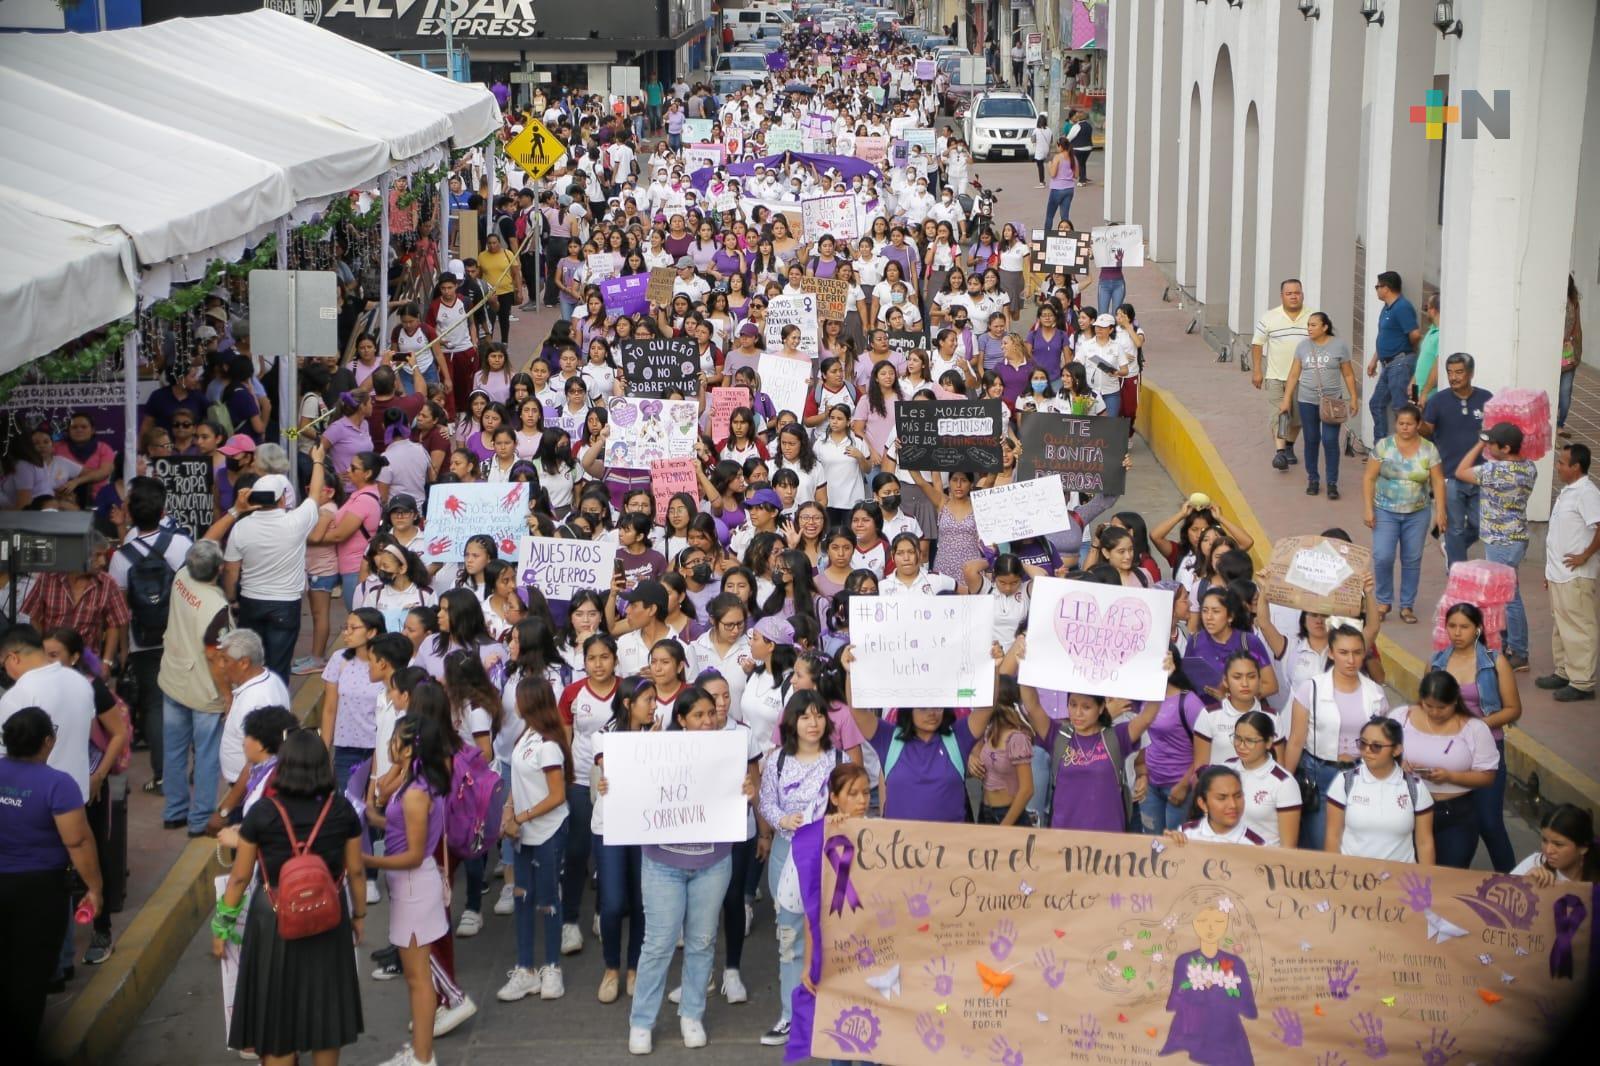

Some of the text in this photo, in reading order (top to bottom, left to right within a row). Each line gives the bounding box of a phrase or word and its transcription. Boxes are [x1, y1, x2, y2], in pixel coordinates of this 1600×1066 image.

[416, 19, 537, 36] EXPRESS
[649, 340, 693, 357] QUIERO
[889, 338, 915, 348] amino
[628, 346, 644, 360] YO
[648, 356, 680, 366] VIVIR,
[657, 368, 671, 378] NO
[900, 405, 986, 418] Les MOLESTA
[924, 422, 937, 432] EL
[939, 419, 993, 433] FEMINISMO
[1062, 418, 1091, 437] TE
[901, 435, 920, 445] QUE
[1045, 444, 1104, 463] BONITA
[182, 462, 208, 476] TIPO
[174, 475, 207, 494] ROPA
[530, 541, 602, 563] NUESTROS
[545, 564, 597, 584] CUERPOS
[174, 578, 202, 609] PRENSA
[545, 583, 561, 595] SE
[856, 602, 956, 622] #8M no se
[1060, 598, 1145, 631] LIBRES
[864, 631, 919, 656] felicita
[1066, 623, 1147, 652] PODEROSAS
[892, 657, 930, 677] lucha
[660, 783, 689, 805] NO
[641, 803, 708, 832] SOBREVIVIR
[856, 827, 947, 871] Estar
[969, 844, 999, 872] en
[1009, 834, 1040, 873] el
[1203, 858, 1233, 881] es
[949, 876, 1031, 917] Primer
[1043, 887, 1101, 911] acto
[977, 997, 1012, 1009] MENTE
